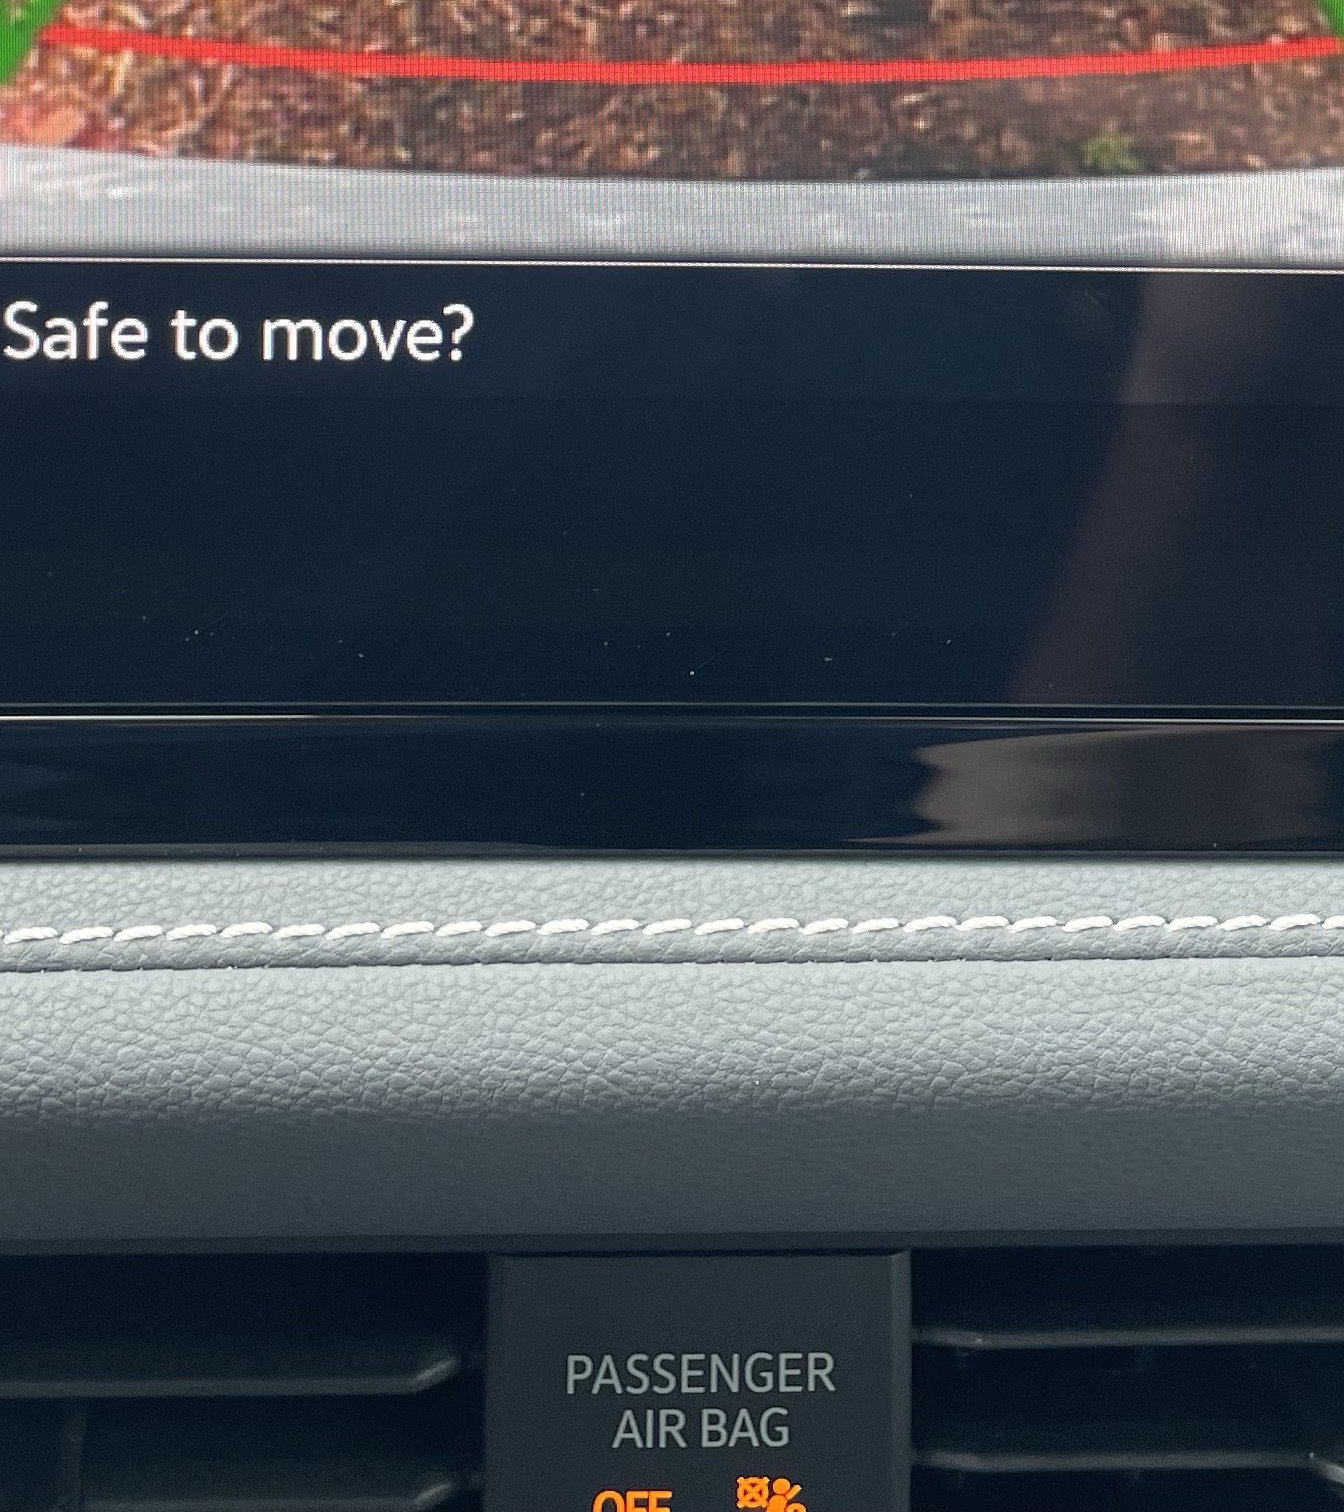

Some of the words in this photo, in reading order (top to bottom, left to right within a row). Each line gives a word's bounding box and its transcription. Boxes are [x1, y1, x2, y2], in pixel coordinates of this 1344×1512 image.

[3, 300, 149, 361] Safe
[170, 309, 239, 361] to
[262, 303, 474, 362] move?
[567, 1353, 835, 1394] PASSENGER
[613, 1409, 686, 1448] AIR
[702, 1408, 788, 1447] BAG
